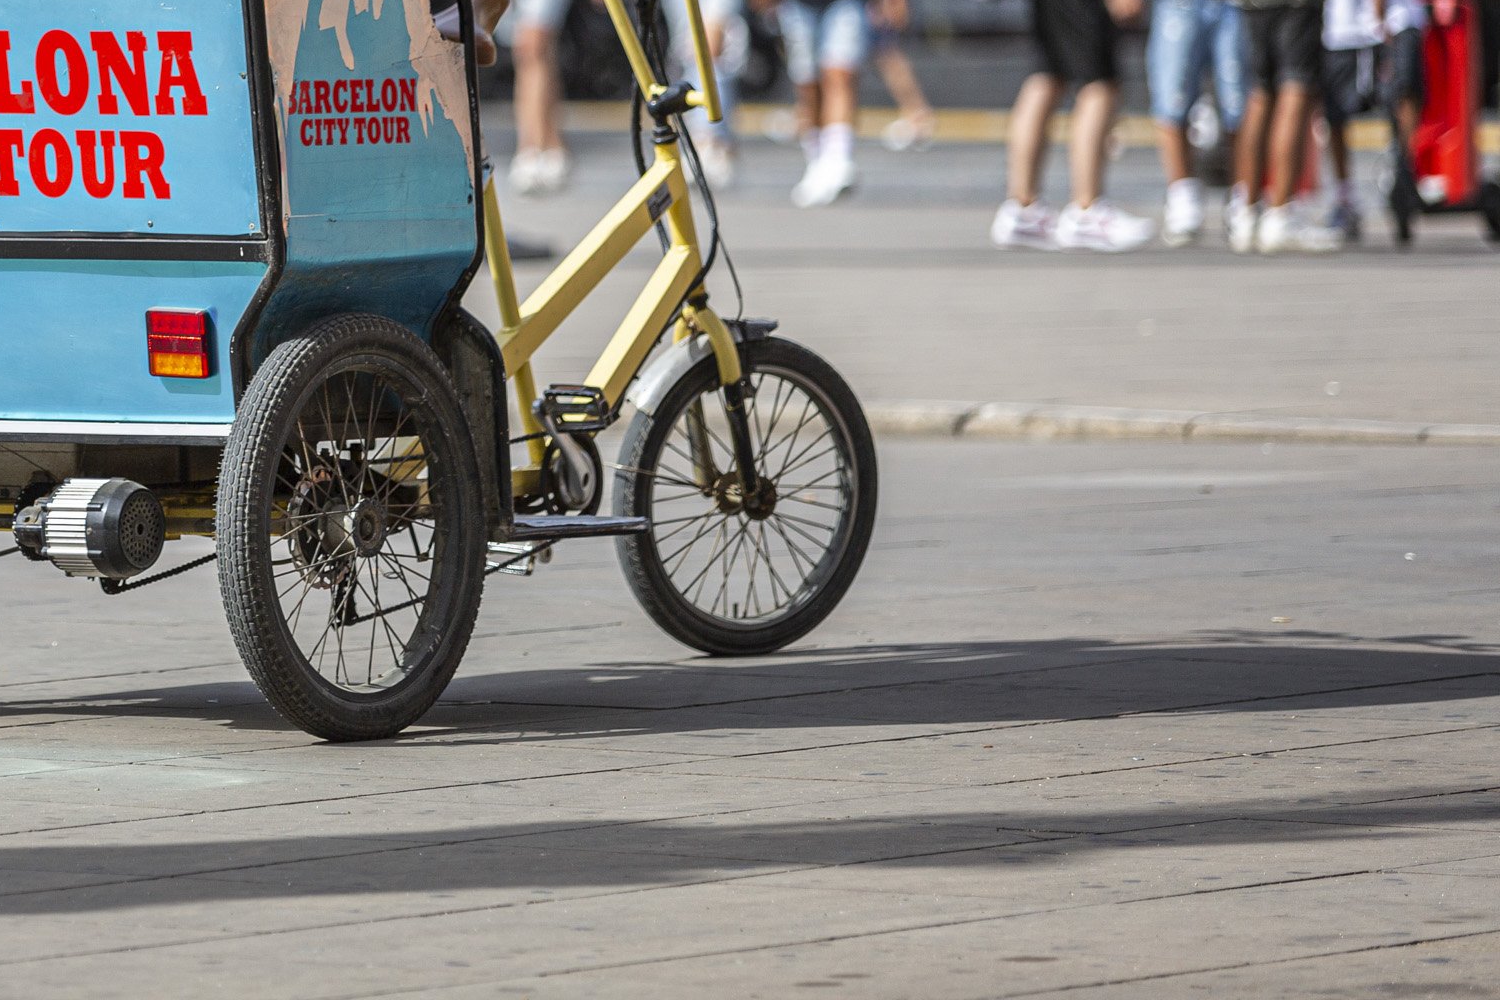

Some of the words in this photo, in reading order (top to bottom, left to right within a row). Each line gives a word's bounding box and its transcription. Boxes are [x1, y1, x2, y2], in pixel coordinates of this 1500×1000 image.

[288, 78, 417, 115] ARCELON
[300, 117, 349, 147] CITY
[353, 116, 411, 144] TOUR
